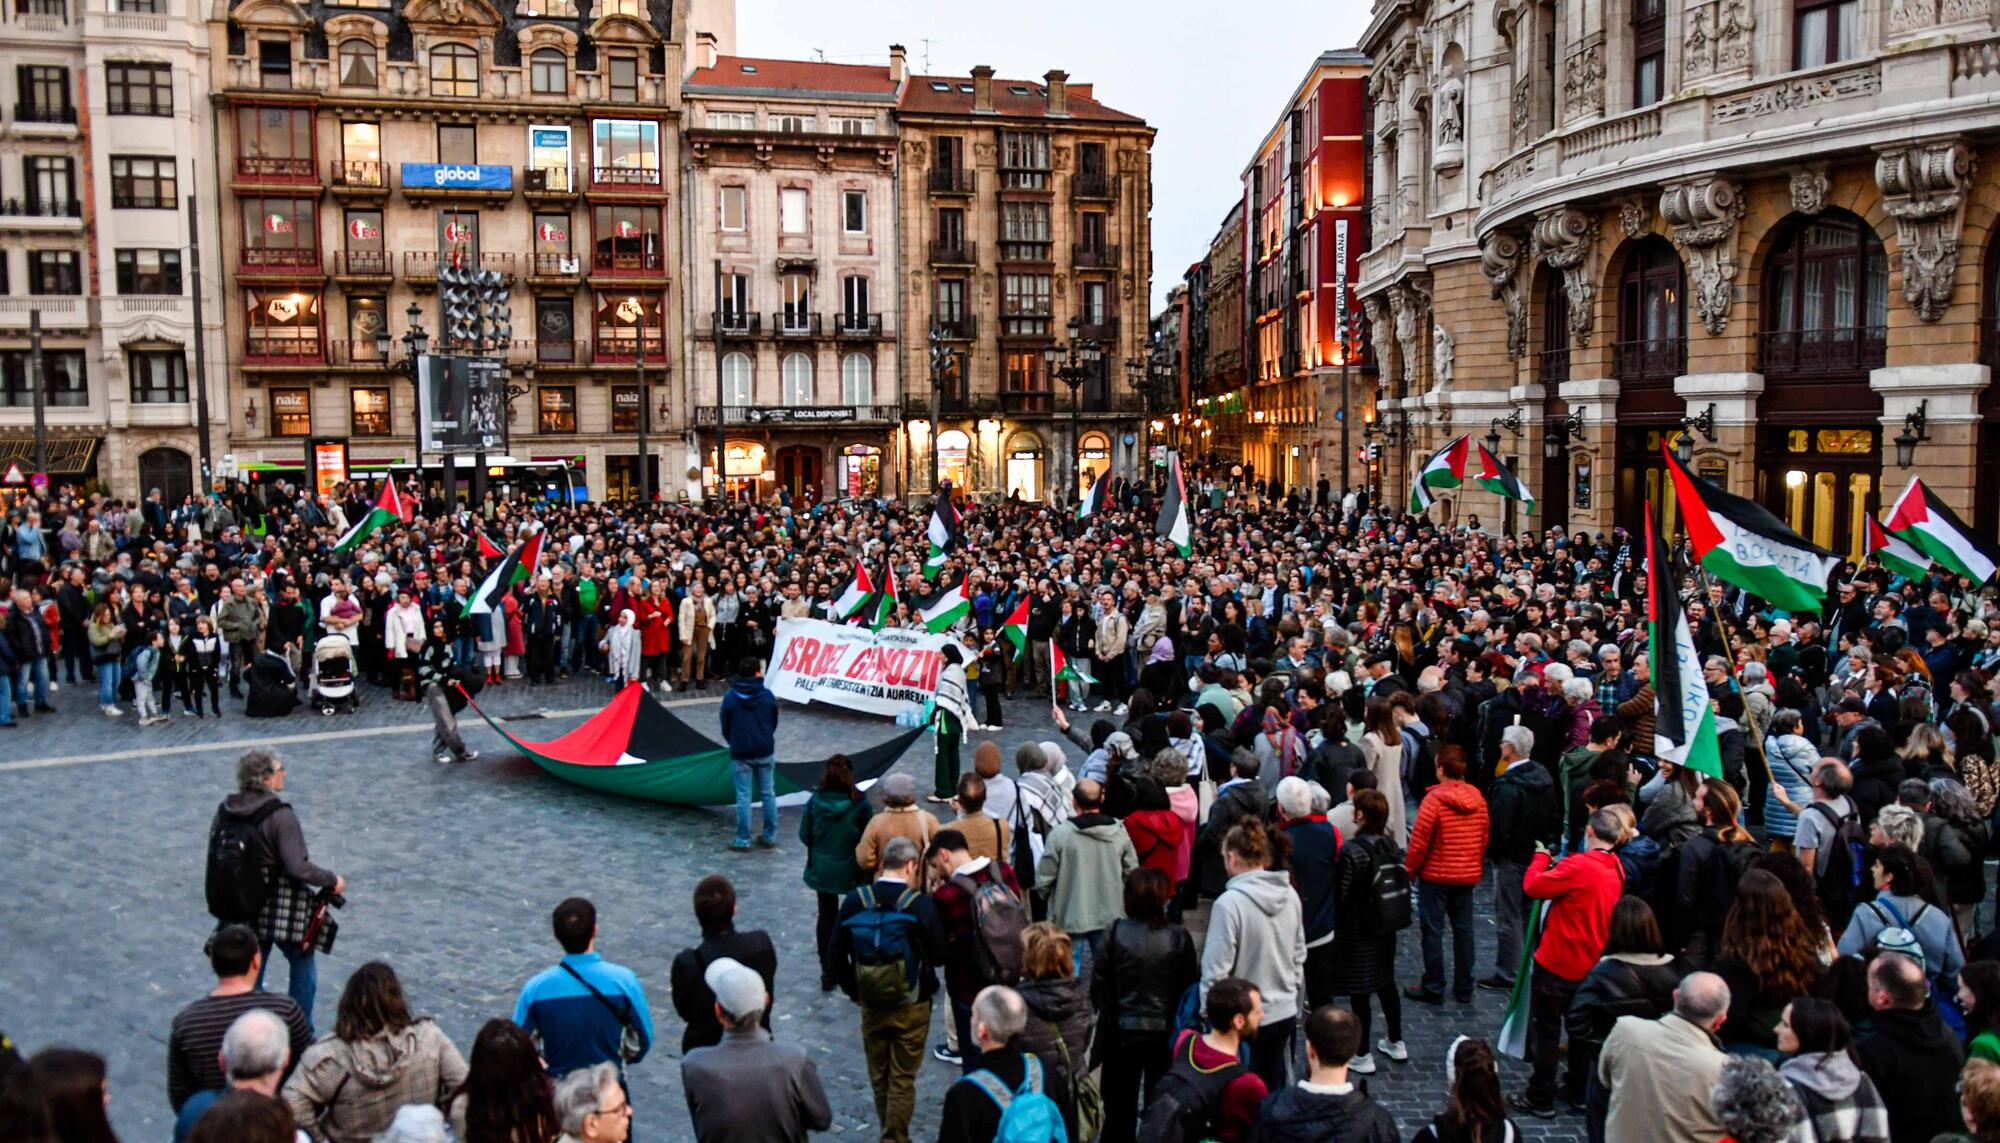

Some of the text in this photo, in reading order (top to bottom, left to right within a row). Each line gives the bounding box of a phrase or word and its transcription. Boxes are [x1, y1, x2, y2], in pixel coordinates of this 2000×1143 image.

[435, 166, 480, 185] global
[1337, 271, 1345, 306] PALACE
[274, 302, 291, 313] BG
[794, 410, 815, 418] LOCAL
